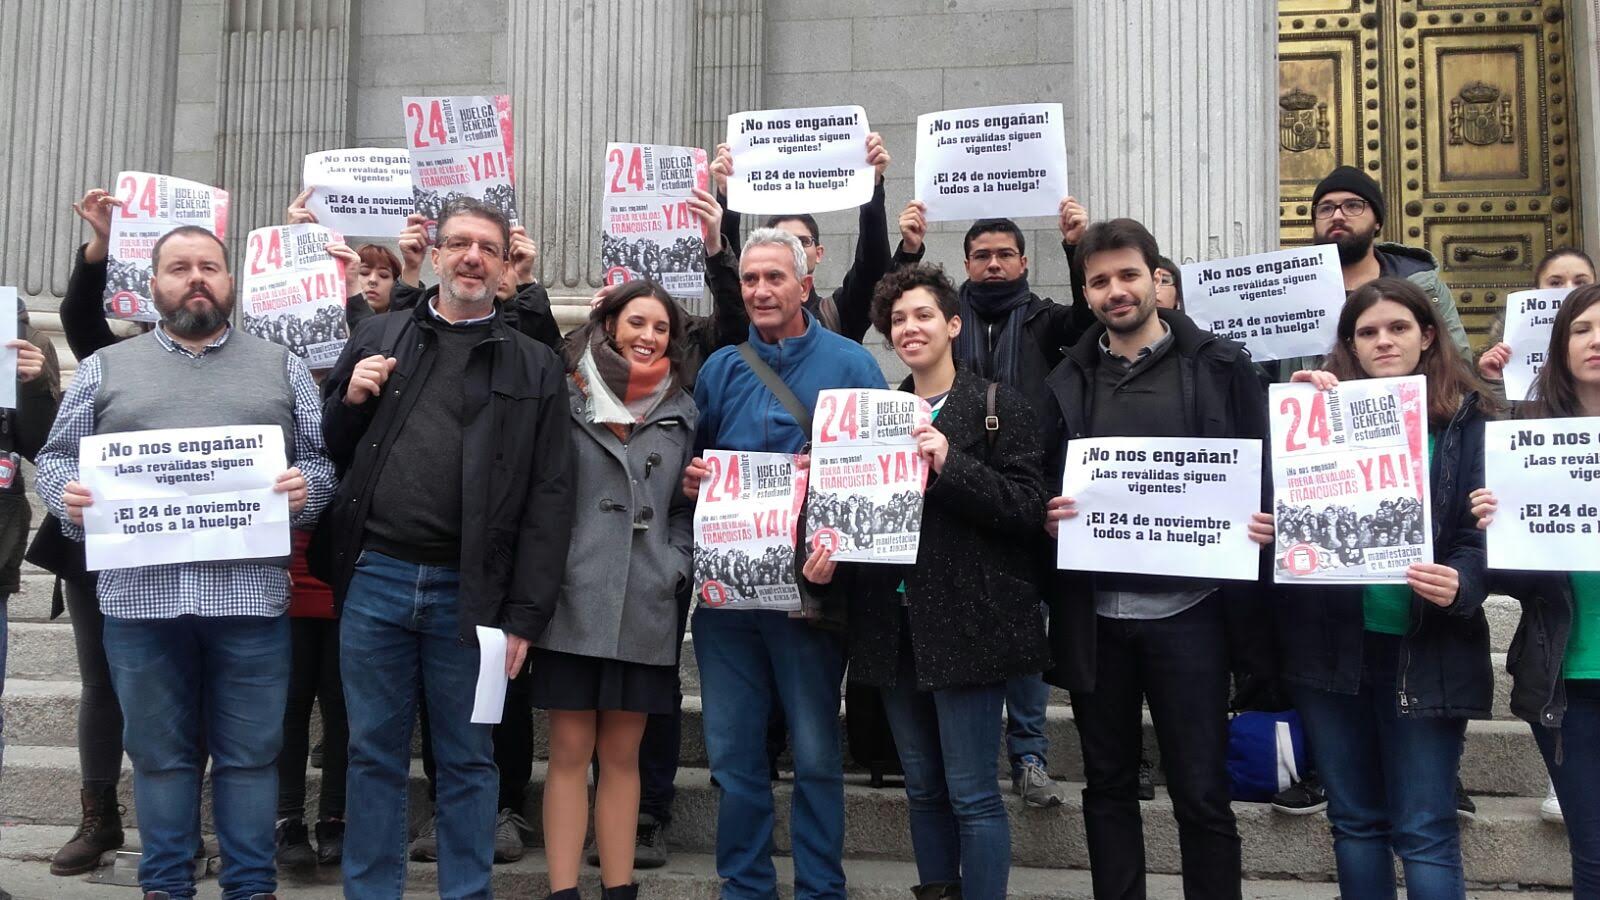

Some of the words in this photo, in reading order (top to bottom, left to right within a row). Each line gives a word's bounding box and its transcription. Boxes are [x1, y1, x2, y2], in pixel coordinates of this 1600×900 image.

[460, 105, 493, 120] HUELGA
[407, 101, 447, 148] 24
[462, 118, 496, 131] GENERAL
[741, 119, 763, 133] ¡No
[768, 119, 791, 129] nos
[796, 114, 858, 130] engañan!
[930, 120, 950, 135] ¡No
[956, 118, 979, 129] nos
[984, 112, 1049, 129] engañan!
[750, 136, 769, 146] ¡Las
[819, 133, 850, 142] siguen
[938, 136, 957, 147] ¡Las
[1009, 131, 1041, 141] siguen
[778, 143, 821, 154] vigentes!
[966, 143, 1011, 155] vigentes!
[468, 152, 505, 181] YA!
[609, 147, 645, 193] 24
[660, 156, 692, 169] HUELGA
[660, 168, 694, 180] GENERAL
[748, 171, 761, 183] ¡El
[765, 170, 778, 180] 24
[783, 169, 795, 179] de
[799, 168, 855, 179] noviembre
[934, 173, 948, 185] ¡El
[952, 172, 966, 182] 24
[971, 171, 983, 181] de
[988, 168, 1046, 180] noviembre
[753, 182, 781, 191] todos
[785, 182, 791, 190] a
[795, 181, 804, 189] la
[809, 179, 848, 189] huelga!
[940, 184, 969, 194] todos
[973, 184, 979, 192] a
[984, 183, 993, 192] la
[998, 180, 1039, 192] huelga!
[120, 176, 158, 218] 24
[175, 188, 210, 199] HUELGA
[325, 195, 338, 204] ¡El
[341, 195, 354, 203] 24
[358, 196, 369, 204] de
[175, 200, 211, 209] GENERAL
[330, 205, 357, 213] todos
[370, 206, 378, 214] la
[662, 201, 698, 230] YA!
[297, 232, 329, 246] HUELGA
[250, 229, 283, 275] 24
[1198, 269, 1221, 285] ¡No
[1226, 266, 1251, 278] nos
[1256, 253, 1323, 274] engañan!
[301, 273, 336, 302] YA!
[1209, 285, 1230, 296] ¡Las
[1283, 274, 1317, 284] siguen
[1240, 286, 1287, 301] vigentes!
[1521, 299, 1546, 314] ¡No
[1209, 321, 1225, 333] ¡El
[1229, 318, 1243, 328] 24
[1247, 316, 1260, 326] de
[1264, 309, 1325, 323] noviembre
[1251, 328, 1258, 337] a
[1261, 326, 1272, 335] la
[1276, 319, 1319, 334] huelga!
[1526, 353, 1543, 365] ¡El
[877, 401, 915, 415] HUELGA
[1327, 389, 1343, 433] noviembre
[1350, 394, 1396, 416] HUELGA
[820, 392, 859, 442] 24
[876, 413, 915, 426] GENERAL
[1280, 392, 1331, 452] 24
[1352, 411, 1400, 429] GENERAL
[1332, 434, 1345, 444] de
[1510, 431, 1545, 450] ¡No
[1553, 432, 1590, 445] nos
[102, 442, 132, 461] ¡No
[139, 442, 171, 455] nos
[178, 435, 263, 455] engañan!
[1083, 448, 1109, 465] ¡No
[1116, 450, 1146, 462] nos
[1153, 449, 1238, 466] engañan!
[1524, 455, 1556, 468] ¡Las
[115, 463, 142, 476] ¡Las
[211, 458, 253, 470] siguen
[757, 463, 791, 479] HUELGA
[878, 451, 920, 484] YA!
[1357, 454, 1409, 492] YA!
[155, 472, 215, 485] vigentes!
[706, 455, 741, 502] 24
[758, 477, 791, 489] GENERAL
[820, 474, 877, 489] FRANQUISTAS
[1091, 469, 1117, 480] ¡Las
[1184, 472, 1226, 484] siguen
[1128, 482, 1186, 494] vigentes!
[1290, 481, 1358, 503] FRANQUISTAS
[114, 508, 134, 523] ¡El
[139, 506, 159, 518] 24
[164, 504, 181, 517] de
[186, 500, 261, 515] noviembre
[1520, 504, 1542, 520] ¡El
[1548, 504, 1571, 517] 24
[1577, 504, 1597, 517] de
[123, 522, 163, 534] todos
[168, 520, 177, 531] a
[182, 518, 194, 529] la
[199, 515, 252, 529] huelga!
[753, 509, 787, 539] YA!
[1086, 513, 1105, 526] ¡El
[1110, 513, 1128, 525] 24
[1133, 514, 1150, 526] de
[1155, 516, 1231, 529] noviembre
[1529, 521, 1575, 533] todos
[1581, 523, 1591, 533] a
[1093, 528, 1131, 539] todos
[1136, 530, 1144, 540] a
[1149, 530, 1162, 541] la
[1167, 531, 1221, 546] huelga!
